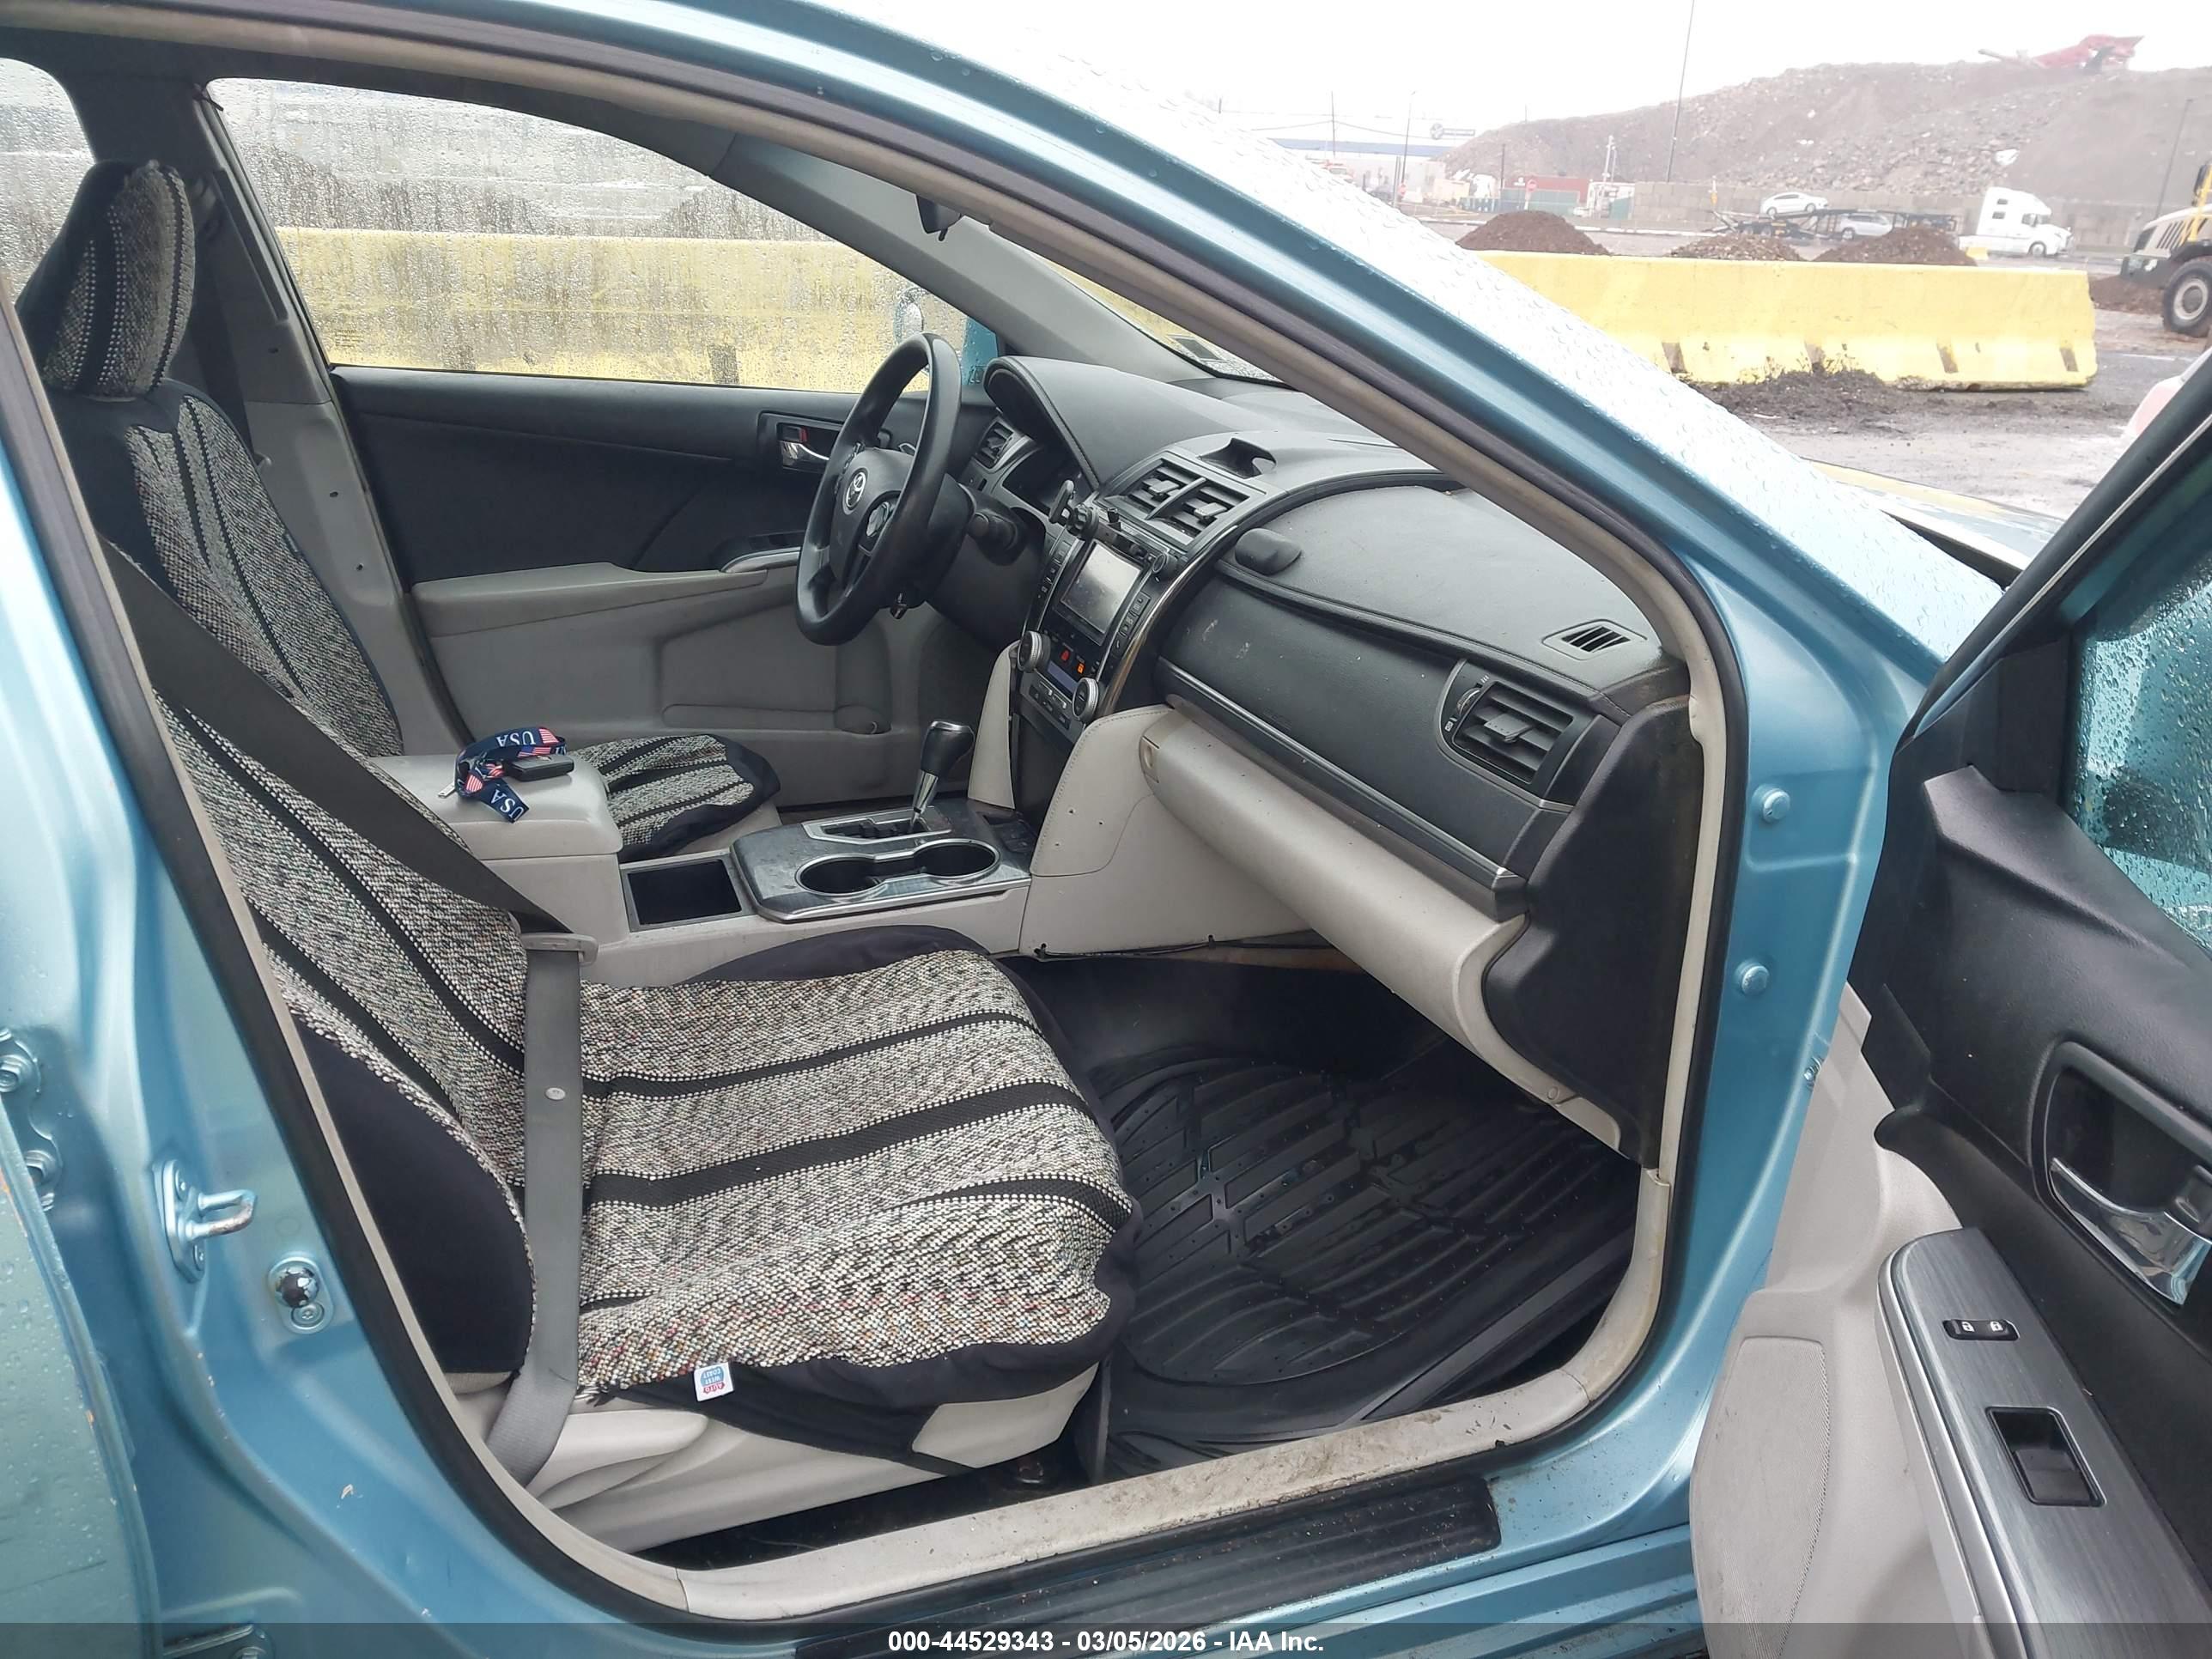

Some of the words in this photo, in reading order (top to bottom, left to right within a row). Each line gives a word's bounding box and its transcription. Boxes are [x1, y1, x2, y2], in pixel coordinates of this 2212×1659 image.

[495, 730, 536, 747] USA
[490, 788, 525, 822] USA
[704, 1382, 723, 1393] AUTO
